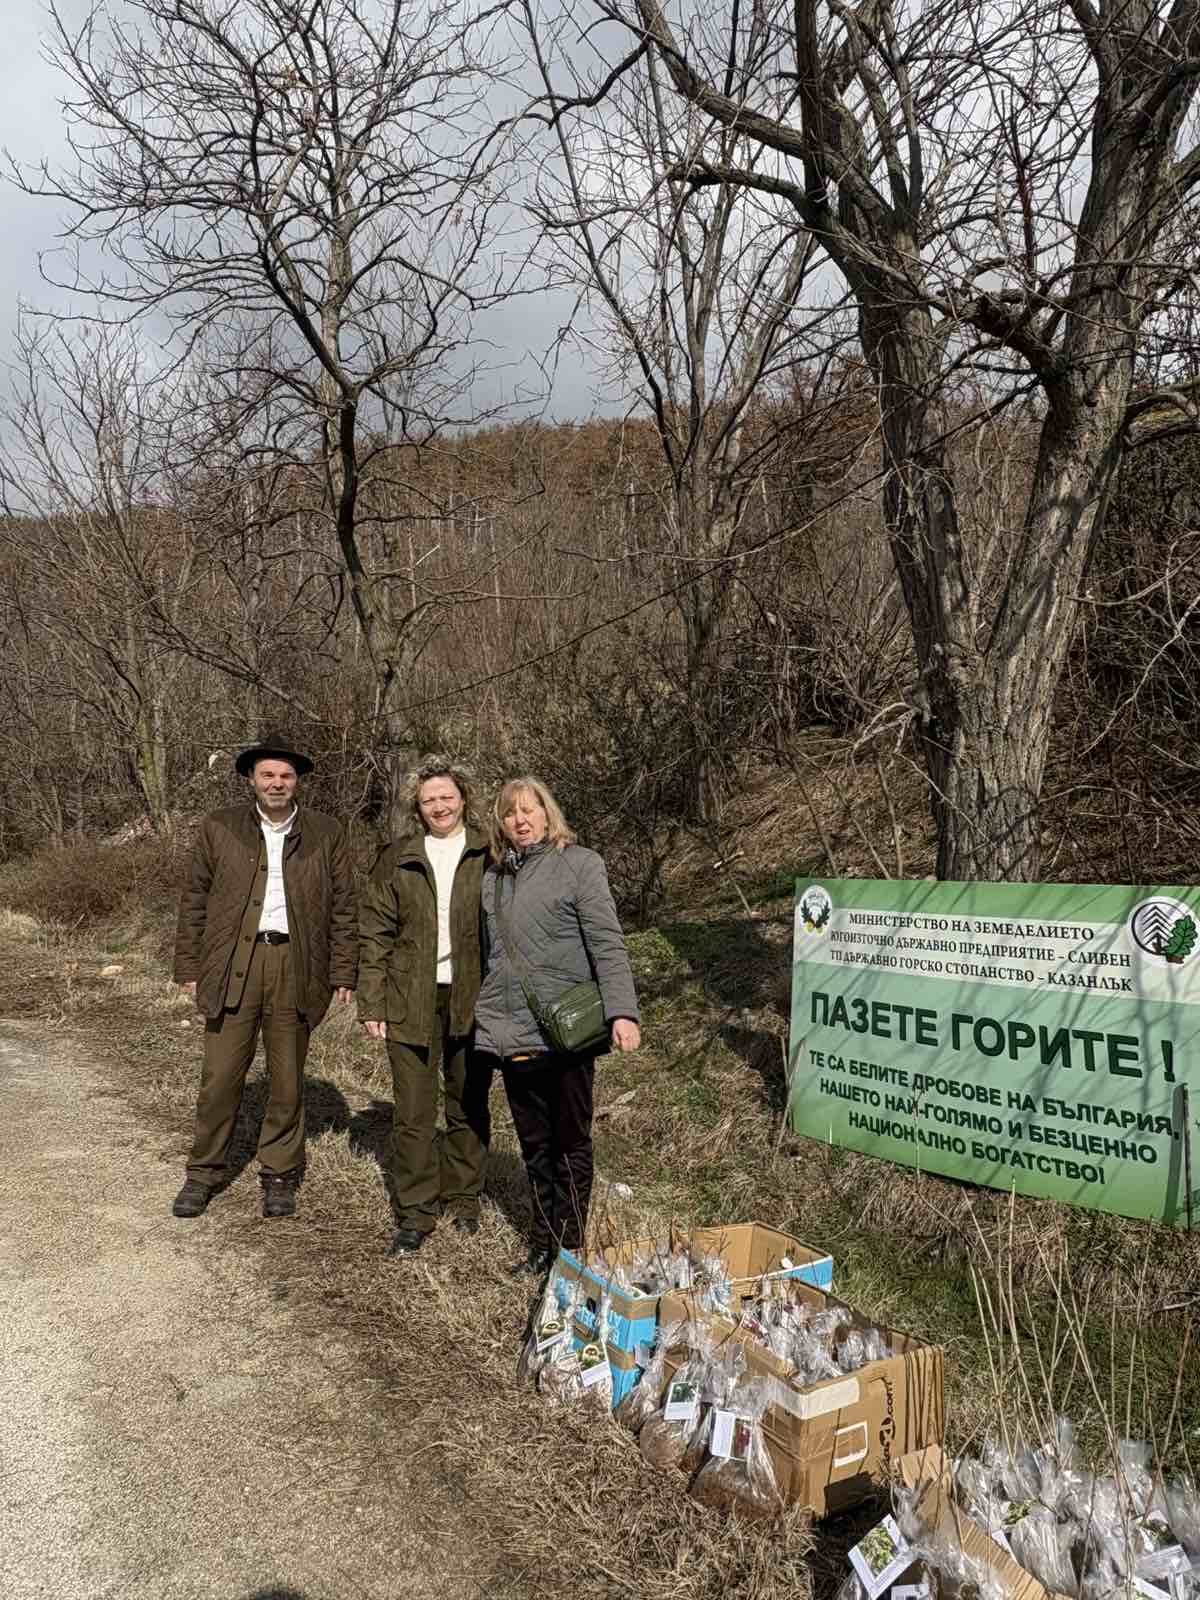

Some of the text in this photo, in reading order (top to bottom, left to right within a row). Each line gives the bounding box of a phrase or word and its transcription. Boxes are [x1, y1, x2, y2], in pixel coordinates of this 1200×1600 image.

[830, 931, 895, 948] ЮГОИЗТОЧНО
[895, 936, 957, 953] ДЪРЖАВНО
[959, 942, 1056, 961] ПРЕДПРИЯТИЕ
[1067, 950, 1132, 967] СЛИВЕН
[849, 913, 1095, 941] МИНИСТЕРСТВО НА ЗЕМЕДЕЛИЕТО
[830, 950, 843, 961] ТП
[844, 951, 898, 968] ДЪРЖАВНО
[899, 957, 943, 973] ГОРСКО
[945, 962, 1035, 983] СТОПАНСТВО
[1047, 971, 1133, 992] КАЗАНЛЪК
[810, 991, 939, 1047] ПАЗЕТЕ
[951, 1013, 1143, 1079] ГОРИТЕ
[809, 1050, 1180, 1140] ТЕ СА БЕЛИТЕ ДРОБОВЕ НА БЪЛГАРИЯ,
[819, 1078, 881, 1108] НАШЕТО
[1008, 1119, 1023, 1140] И
[1028, 1124, 1158, 1164] БЕЗЦЕННО
[848, 1111, 966, 1155] НАЦИОНАЛНО
